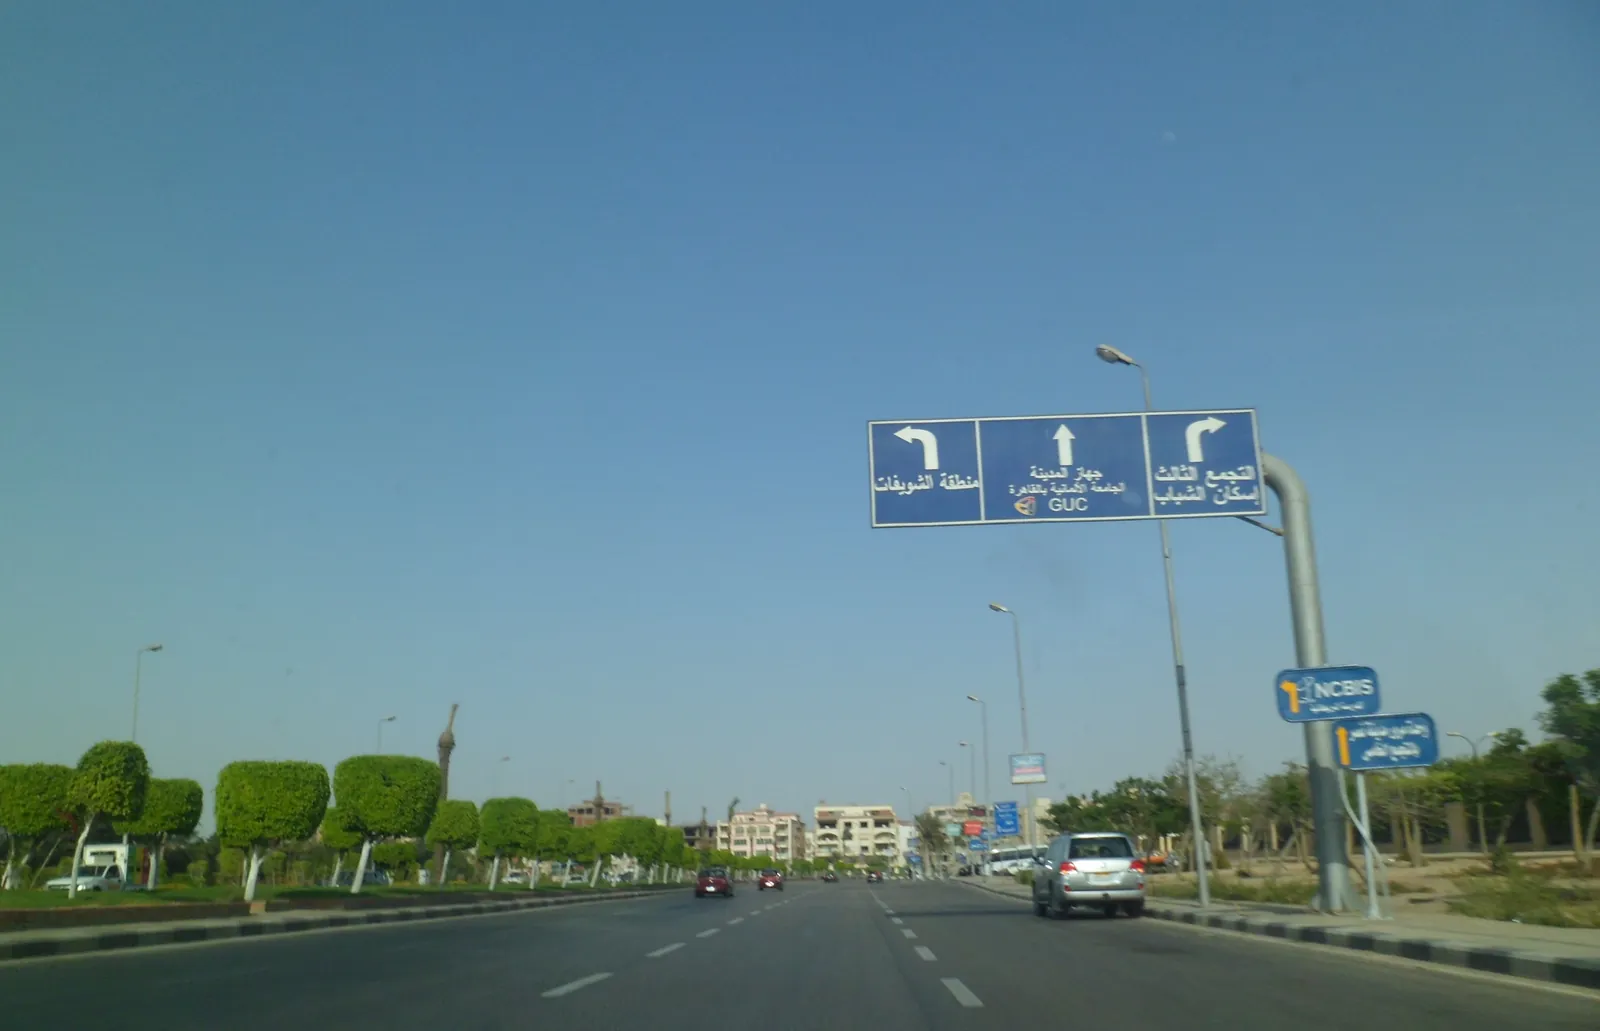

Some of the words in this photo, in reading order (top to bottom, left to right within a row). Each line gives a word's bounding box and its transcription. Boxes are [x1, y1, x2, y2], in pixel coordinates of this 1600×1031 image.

[1030, 466, 1068, 481] المدينة
[1074, 467, 1103, 481] جهاز
[1155, 465, 1198, 481] الثالث
[1205, 466, 1255, 487] التجمع
[875, 474, 934, 494] الشويفات
[939, 472, 979, 490] منطقة
[1091, 482, 1124, 494] الجامعة
[1008, 485, 1048, 497] بالقاهرة
[1154, 485, 1205, 505] الشباب
[1049, 497, 1088, 511] GUC
